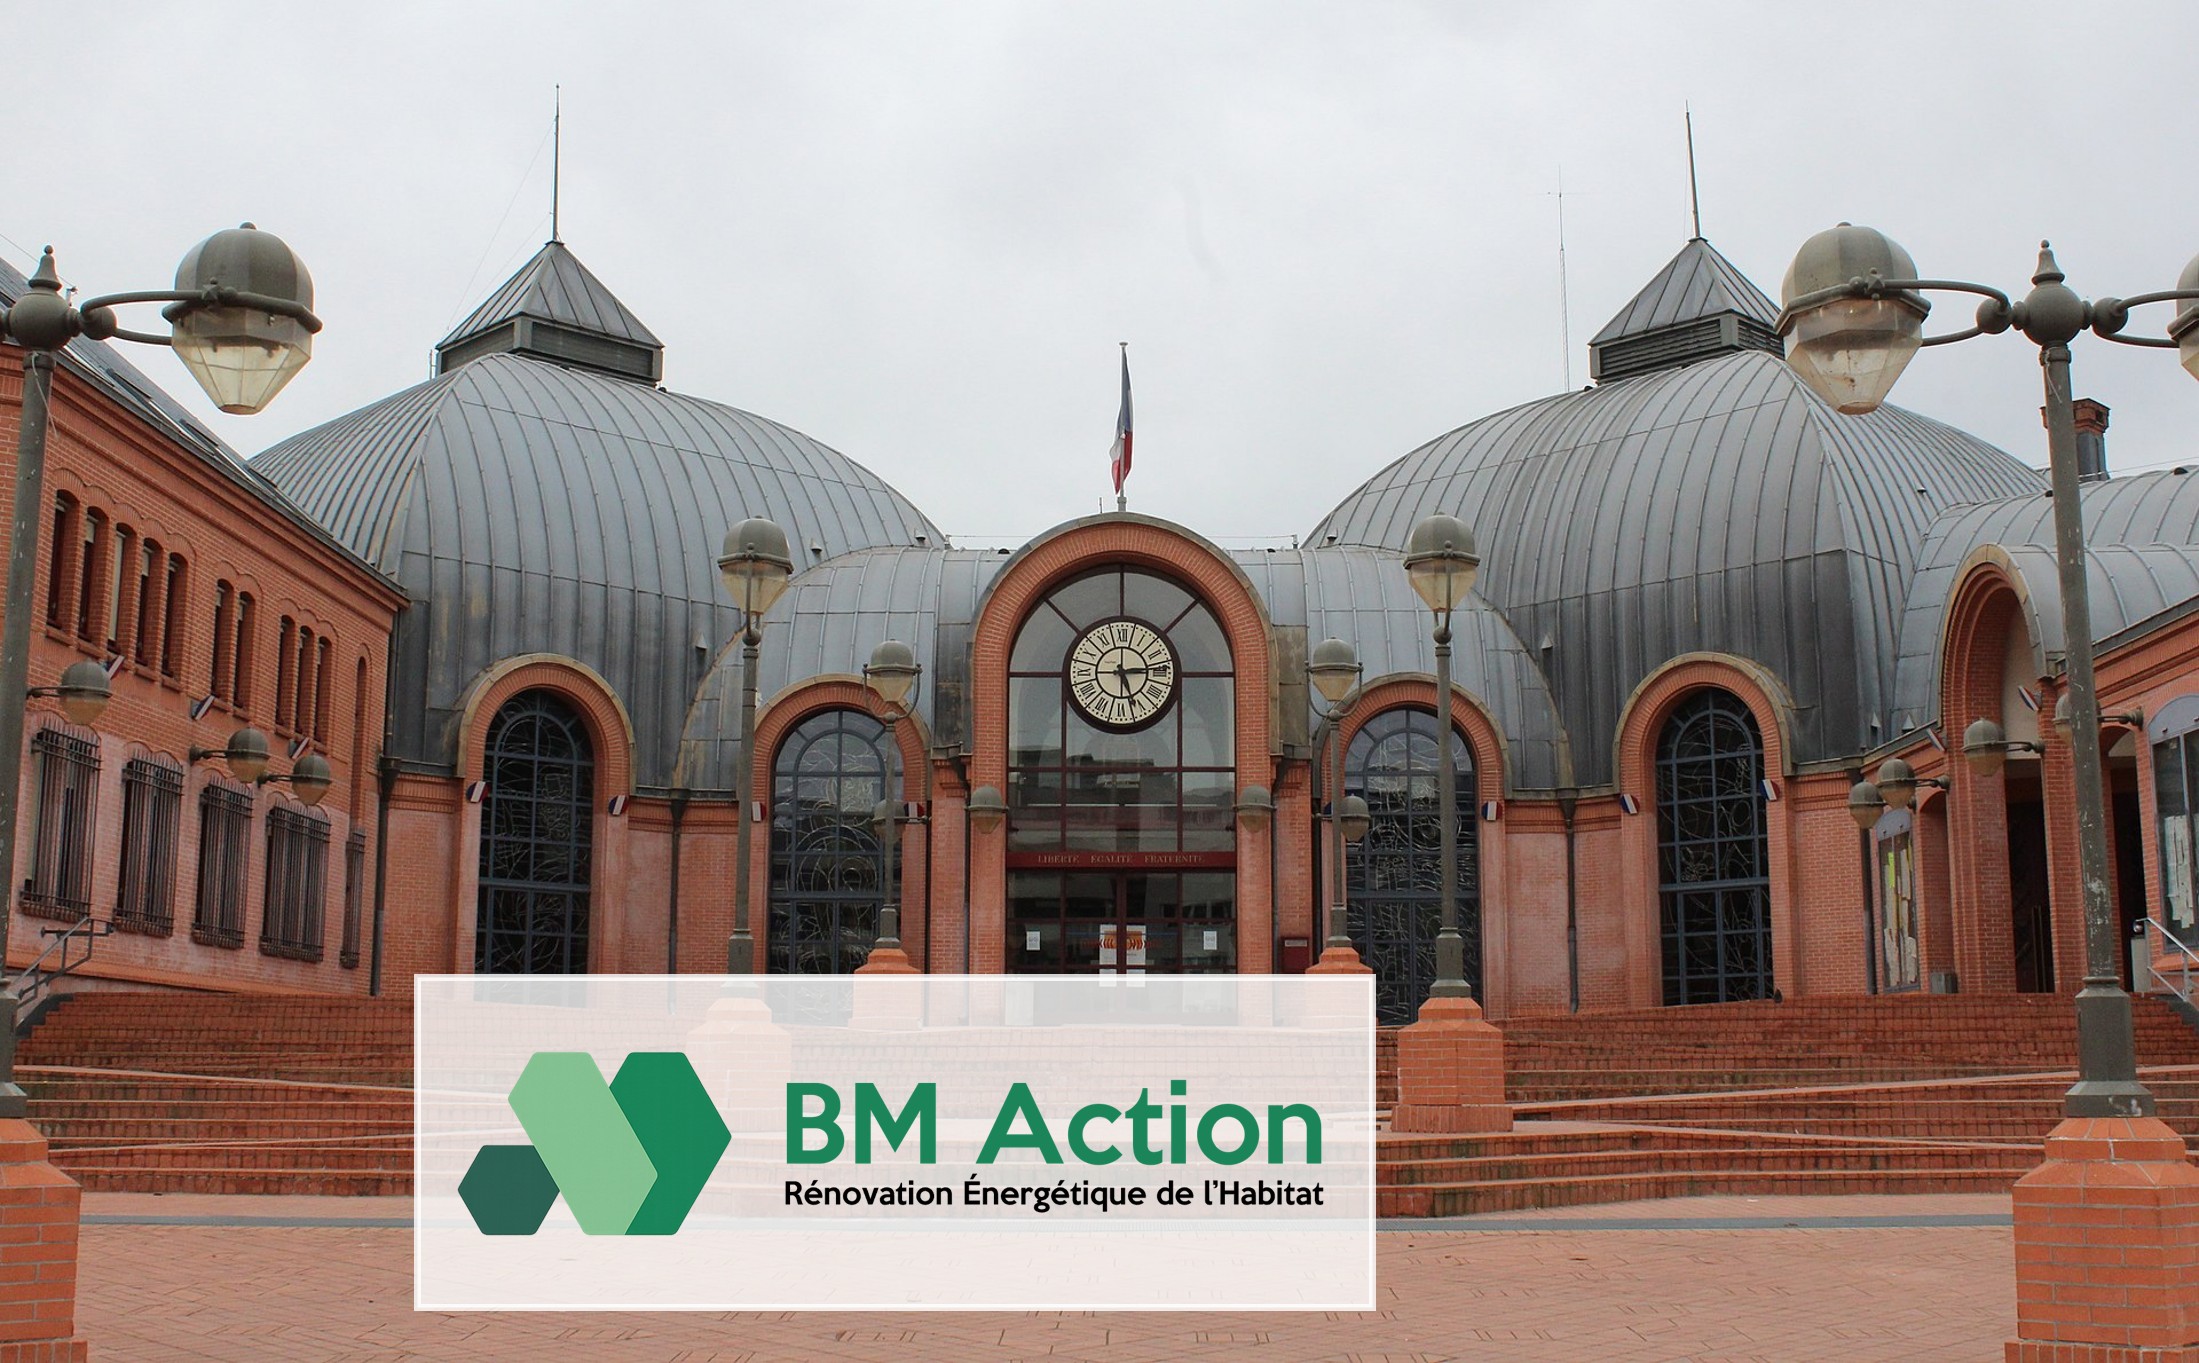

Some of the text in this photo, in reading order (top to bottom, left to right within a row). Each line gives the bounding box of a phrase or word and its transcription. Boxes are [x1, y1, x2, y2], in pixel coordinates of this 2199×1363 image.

[1097, 633, 1110, 648] XI
[1117, 629, 1128, 642] XII
[1137, 634, 1145, 647] I
[1083, 649, 1096, 660] X
[1148, 649, 1161, 660] II
[1077, 668, 1091, 676] IX
[1080, 683, 1096, 699] VIII
[1096, 697, 1109, 713] VII
[1117, 703, 1125, 717] VI
